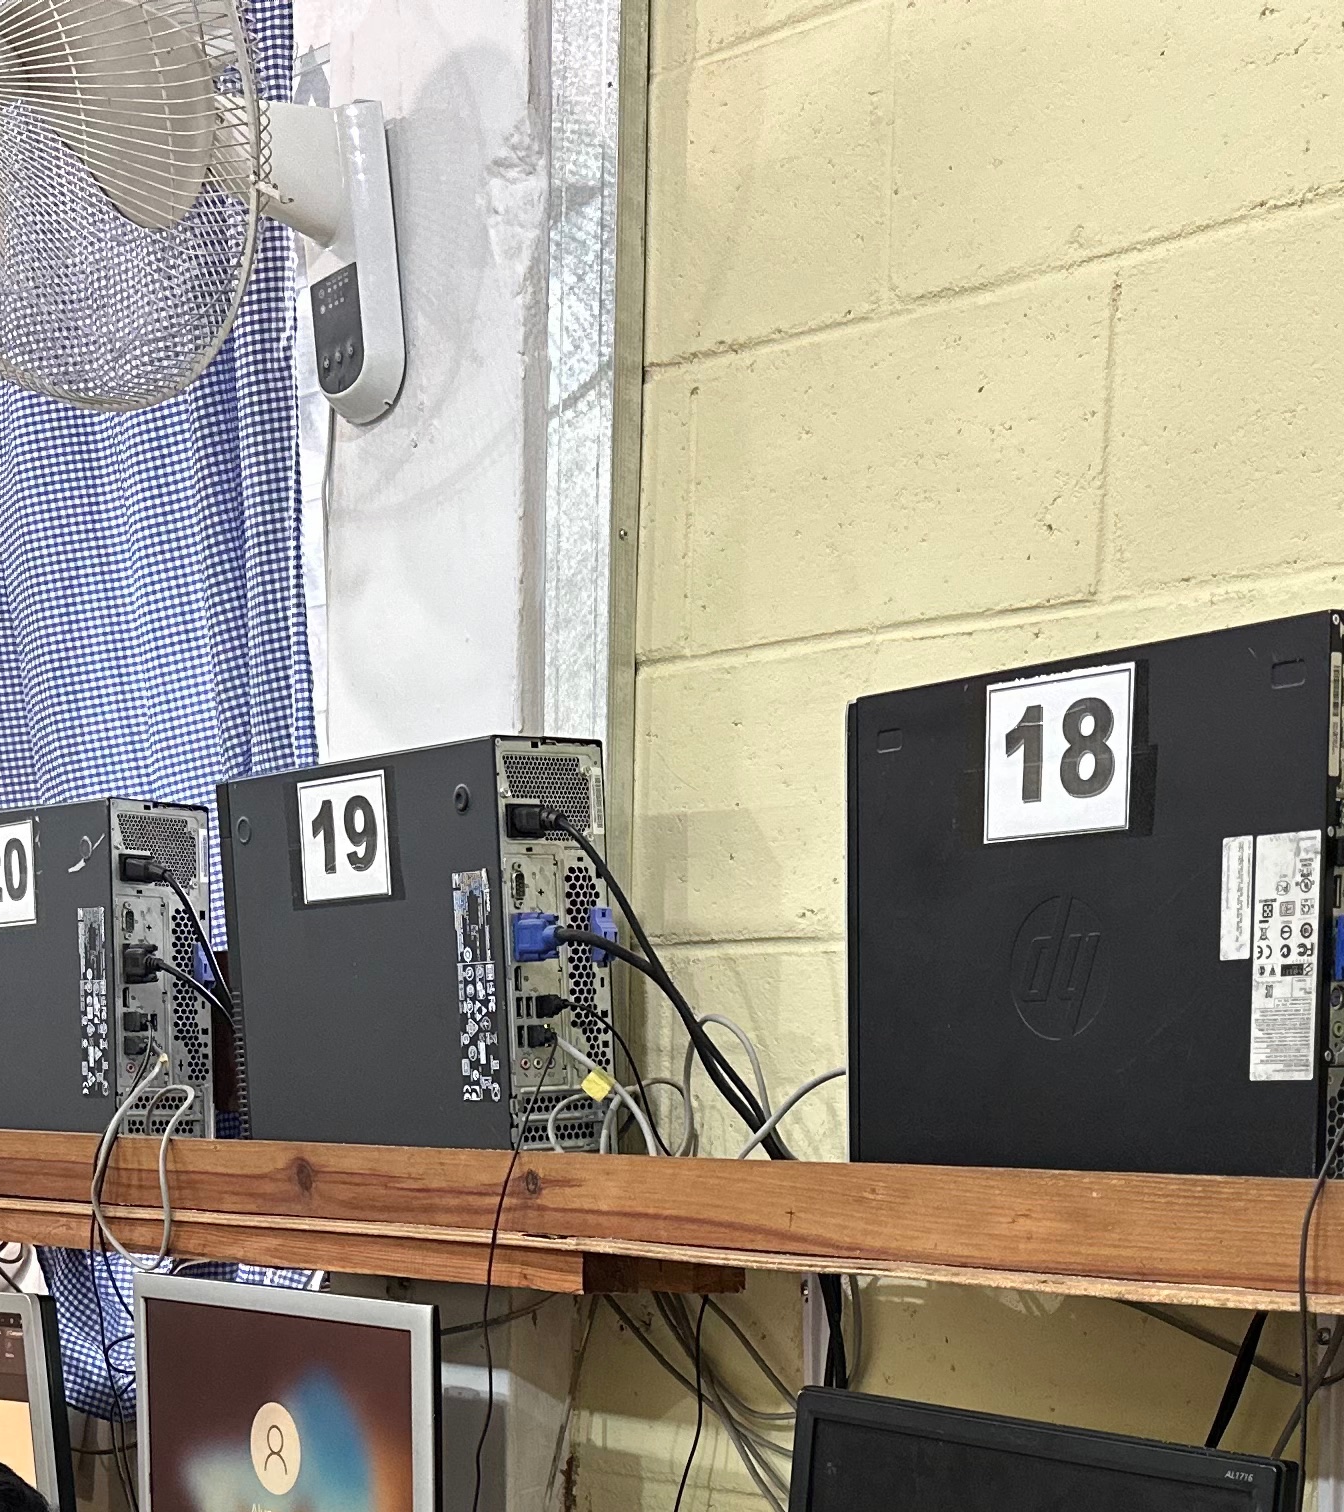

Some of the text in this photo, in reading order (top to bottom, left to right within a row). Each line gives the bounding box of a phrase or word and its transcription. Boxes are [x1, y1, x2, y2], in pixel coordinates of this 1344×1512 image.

[1004, 696, 1117, 805] 18
[310, 794, 379, 876] 19
[1224, 1470, 1254, 1482] AL1716
